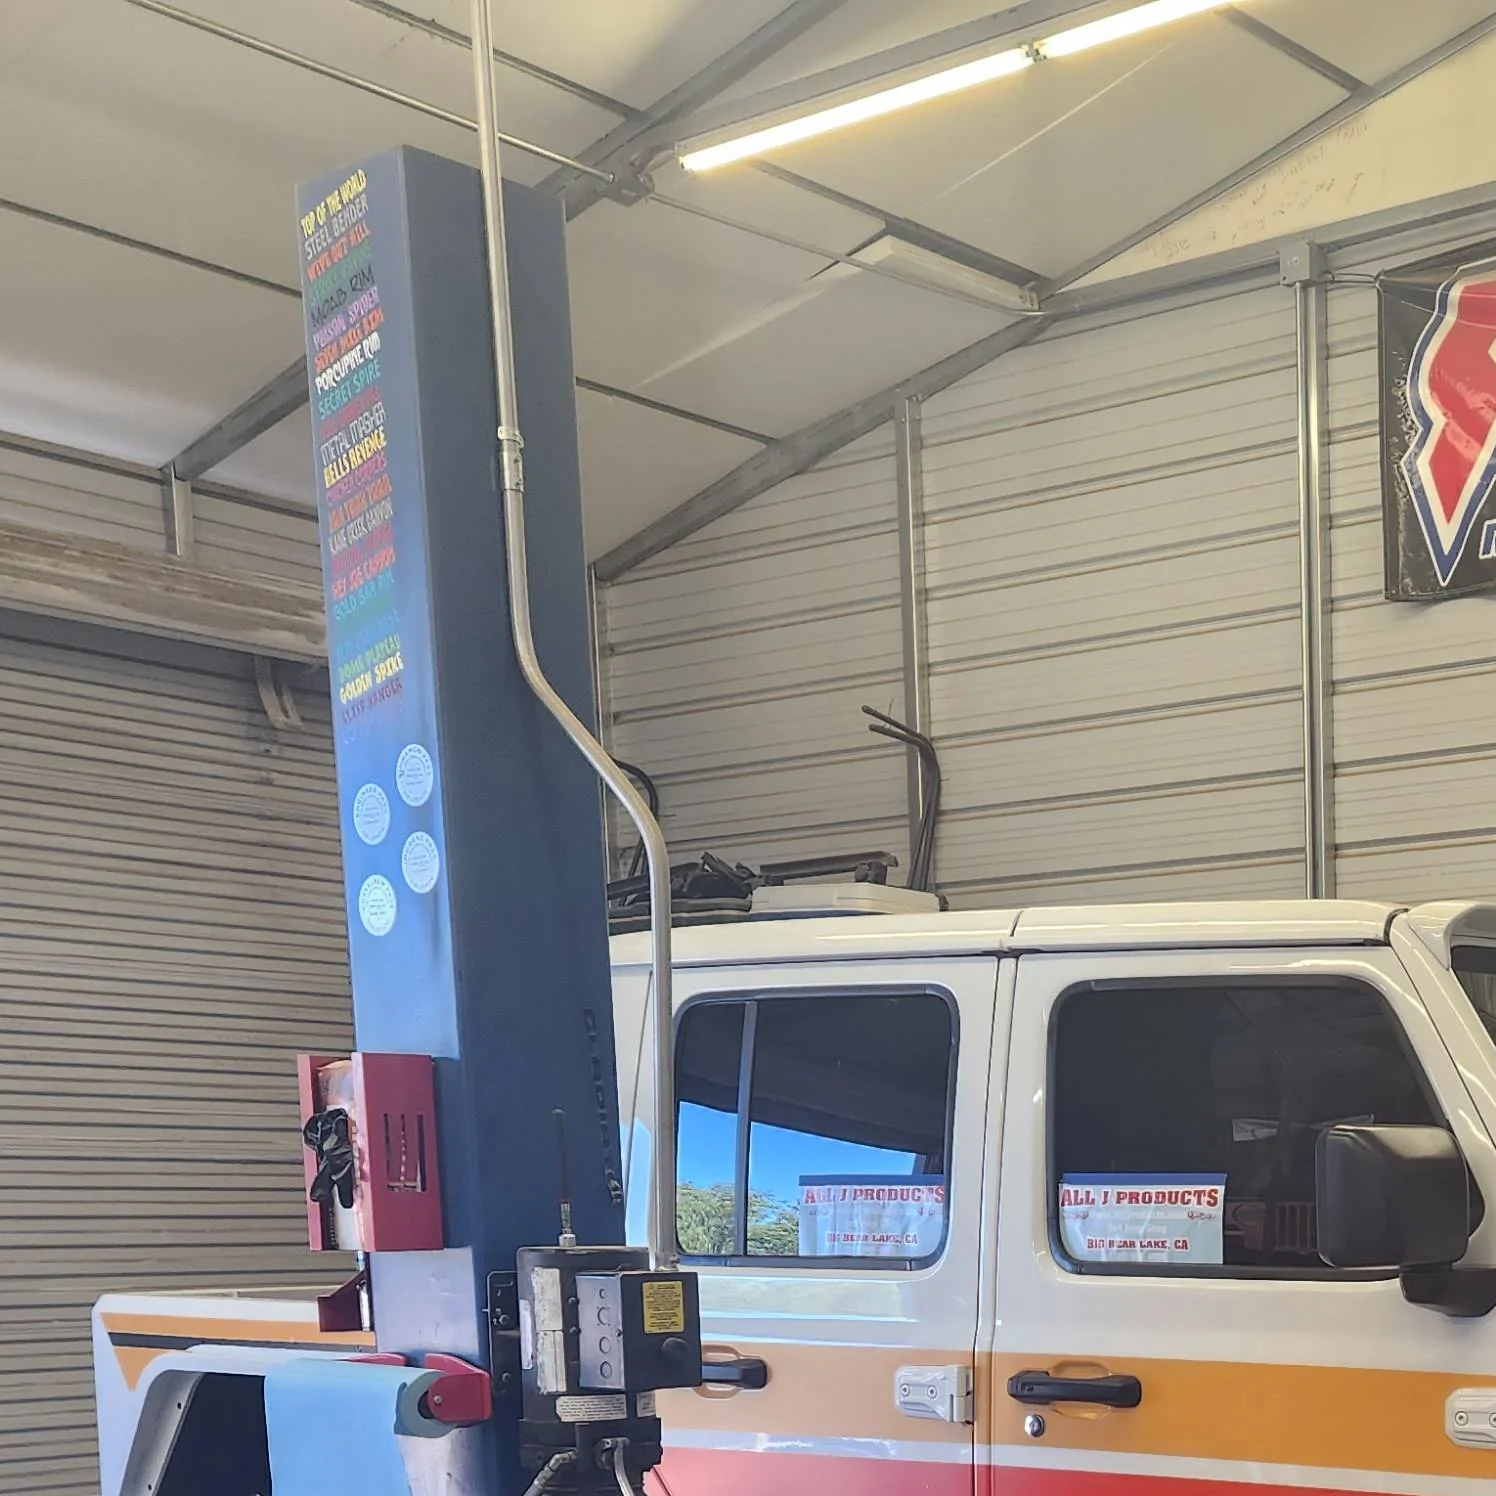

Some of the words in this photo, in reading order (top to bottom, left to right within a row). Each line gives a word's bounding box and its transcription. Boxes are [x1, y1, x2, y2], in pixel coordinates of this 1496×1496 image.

[301, 211, 316, 238] TOP
[316, 201, 326, 226] OF
[326, 190, 341, 216] THE
[340, 169, 367, 204] WORLD
[305, 225, 331, 260] STEEL
[332, 193, 368, 236] BENDER
[311, 288, 347, 327] MOAB
[350, 264, 375, 291] RIM
[313, 314, 346, 351] POISON
[348, 286, 379, 323] SPIDER
[314, 344, 365, 395] PORCUPINE
[318, 381, 353, 420] SECRET
[352, 359, 381, 393] SPIRE
[320, 432, 350, 466] METAL
[350, 400, 387, 443] MASHER
[323, 454, 350, 489] HELLS
[350, 425, 388, 469] REVENGE
[340, 671, 373, 705] GOLDEN
[374, 651, 404, 684] SPIKE
[804, 1187, 834, 1204] ALL
[840, 1188, 848, 1202] J
[852, 1185, 945, 1203] PRODUCTS
[1061, 1188, 1096, 1207] ALL
[1101, 1190, 1110, 1205] J
[1115, 1188, 1219, 1208] PRODUCTS
[1108, 1239, 1136, 1249] BEAR
[1174, 1239, 1189, 1250] CA
